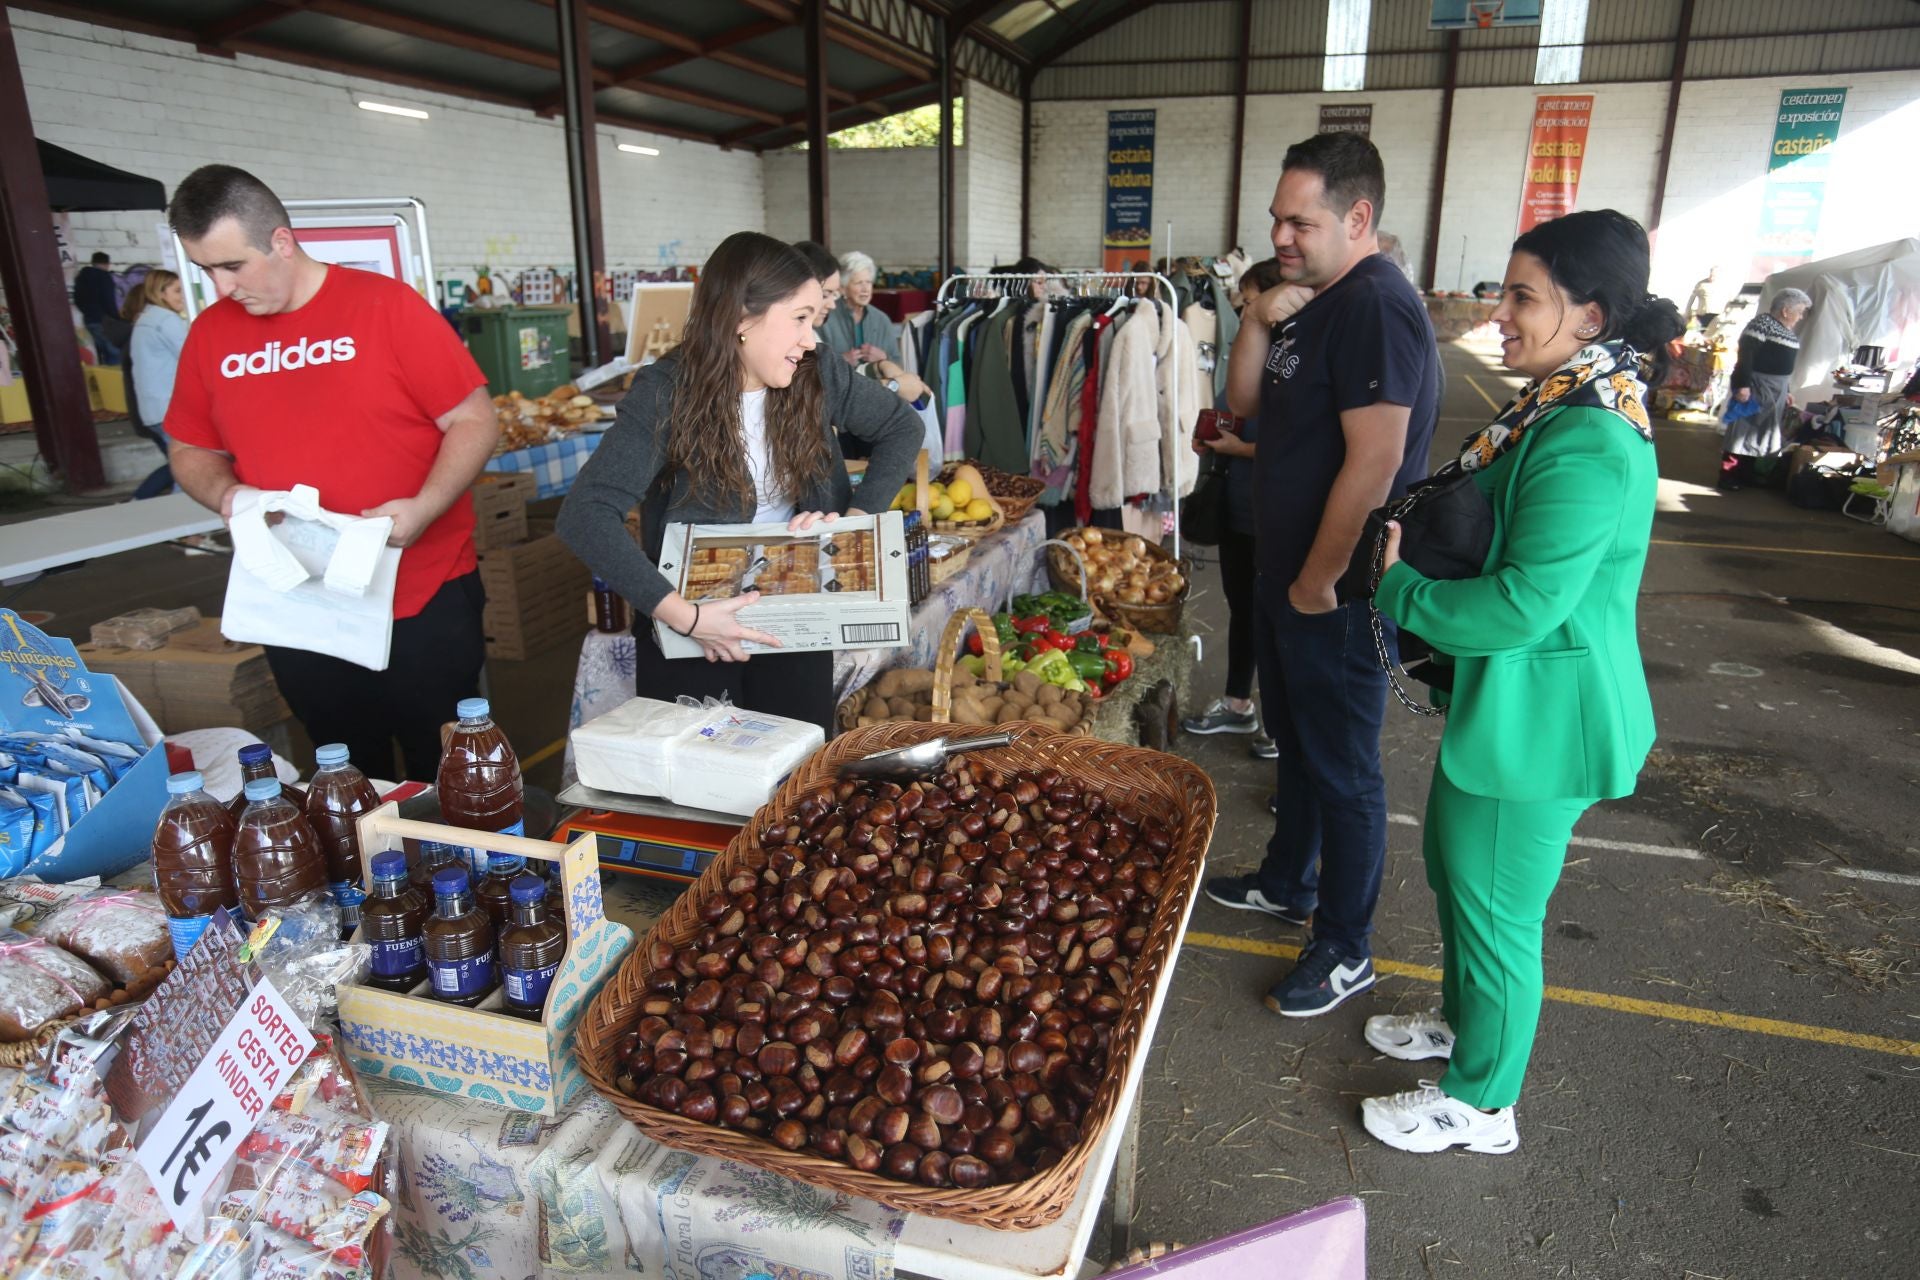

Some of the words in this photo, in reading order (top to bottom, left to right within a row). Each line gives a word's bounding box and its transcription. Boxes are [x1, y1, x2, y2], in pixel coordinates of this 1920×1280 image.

[1538, 100, 1591, 111] certamen
[1783, 92, 1843, 106] certamen
[1779, 108, 1840, 129] exposición
[1109, 145, 1152, 163] castaña
[1532, 139, 1581, 157] castaña
[1108, 169, 1152, 187] valduna
[1529, 163, 1577, 184] valduna
[220, 336, 356, 379] adidas
[15, 883, 63, 902] original
[251, 995, 305, 1066] SORTEO
[237, 1029, 281, 1091] CESTA
[215, 1049, 264, 1122] KINDER
[674, 1168, 707, 1209] Gems
[673, 1213, 694, 1267] Floral
